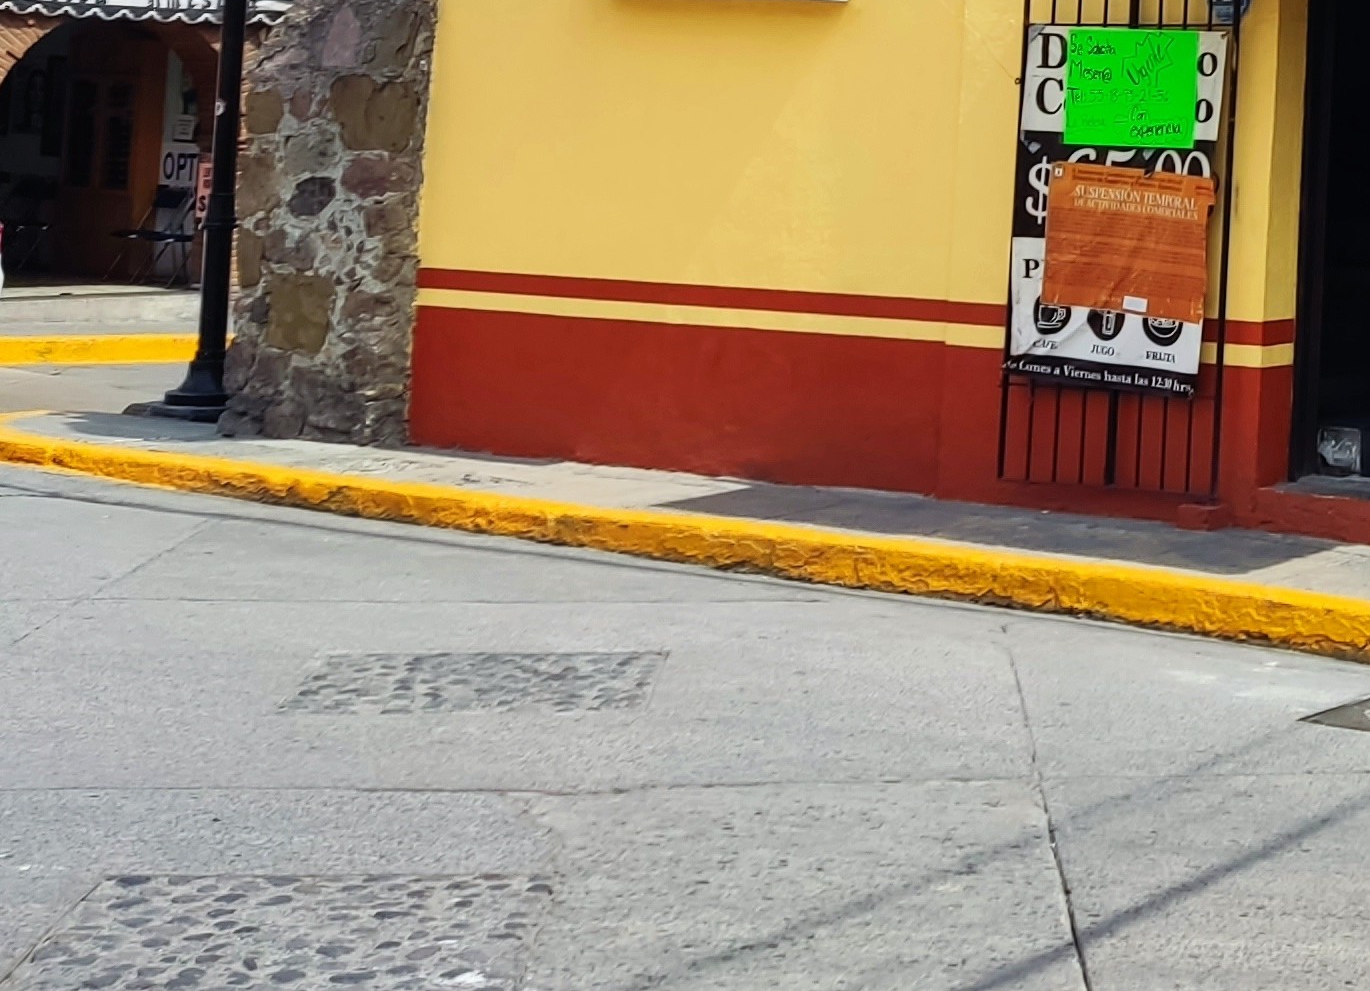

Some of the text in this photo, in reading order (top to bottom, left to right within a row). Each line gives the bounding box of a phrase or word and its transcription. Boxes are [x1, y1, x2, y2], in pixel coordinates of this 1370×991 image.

[1142, 191, 1198, 210] TEMPORAL
[1090, 344, 1115, 357] JUGO
[1145, 351, 1176, 364] FRUTA
[1053, 367, 1061, 376] a
[1063, 364, 1101, 381] Viernes
[1104, 369, 1132, 385] hasta
[1134, 373, 1149, 387] las
